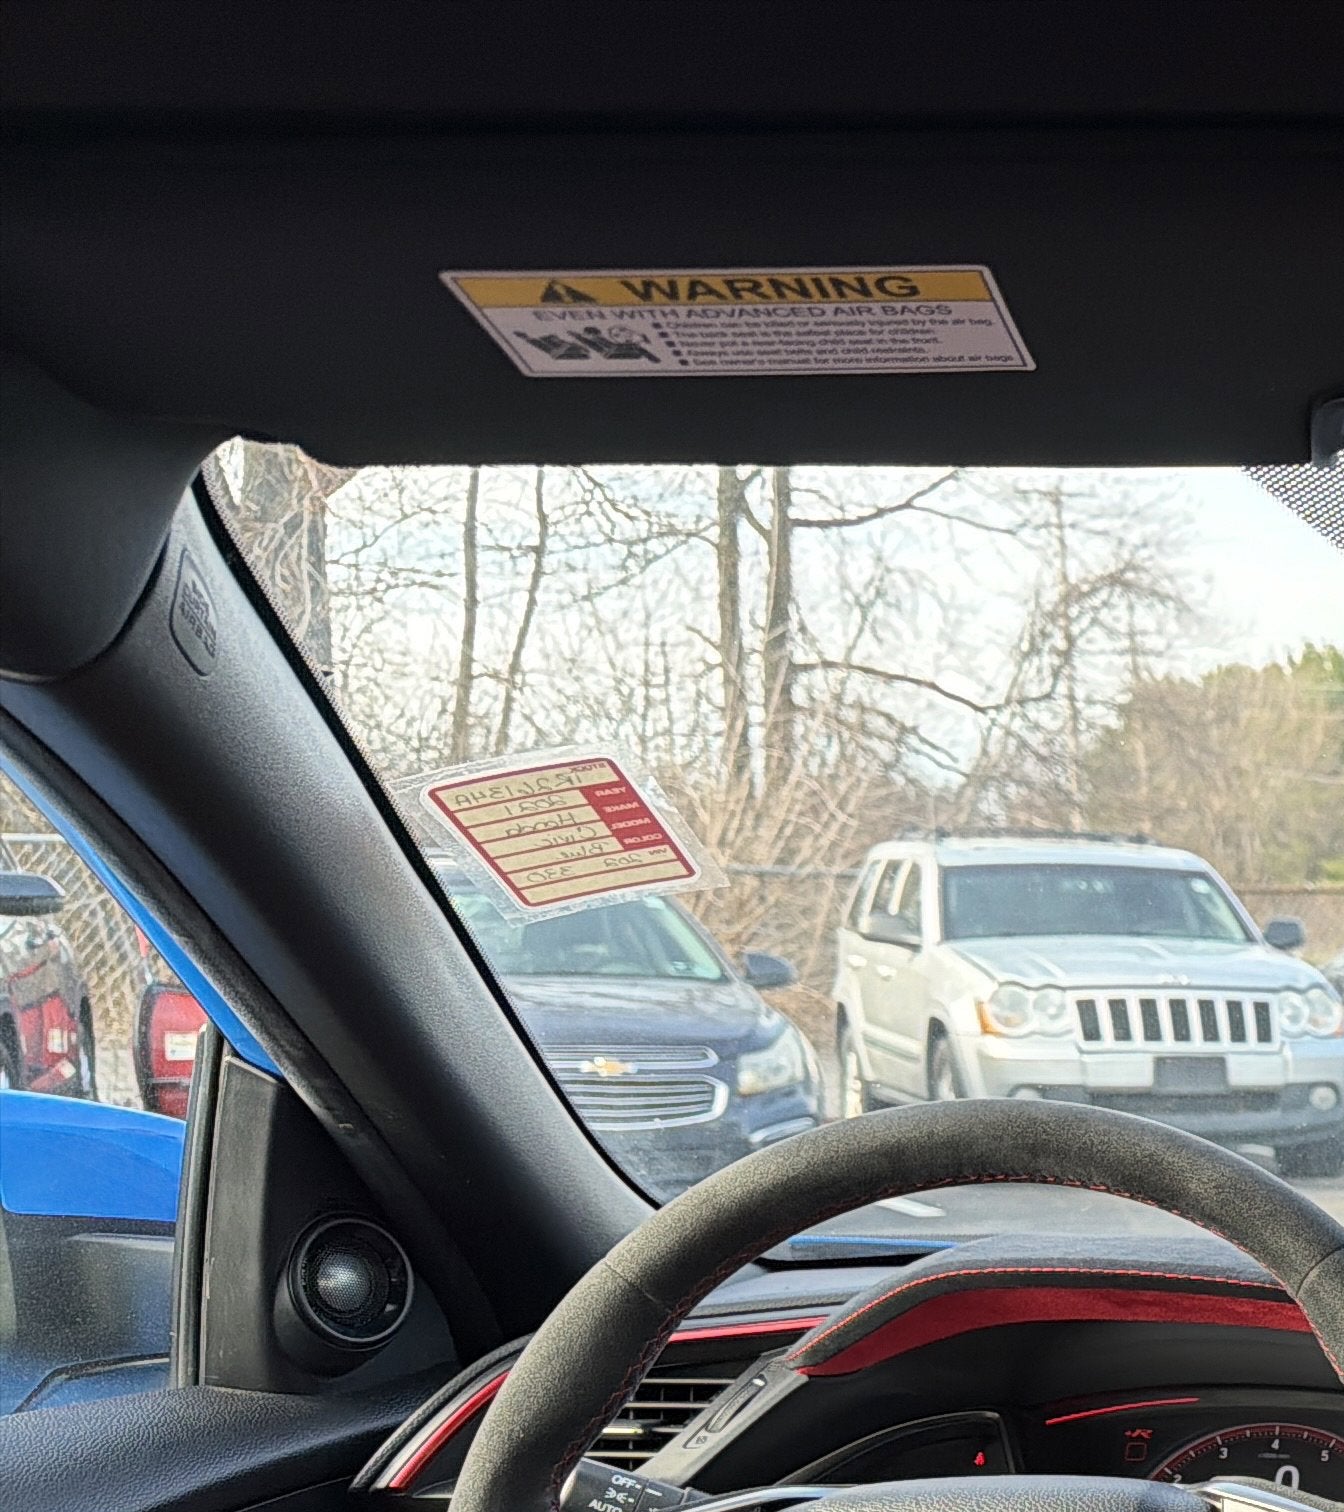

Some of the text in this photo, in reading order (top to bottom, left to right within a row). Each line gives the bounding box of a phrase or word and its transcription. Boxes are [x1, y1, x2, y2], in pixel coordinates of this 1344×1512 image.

[620, 275, 921, 301] WARNING
[532, 304, 953, 321] EVEN WITH ADVANCED AIR BAGS
[1270, 1438, 1280, 1450] 4
[1218, 1447, 1228, 1460] 3
[1320, 1449, 1330, 1463] 5
[611, 1474, 637, 1489] OFF
